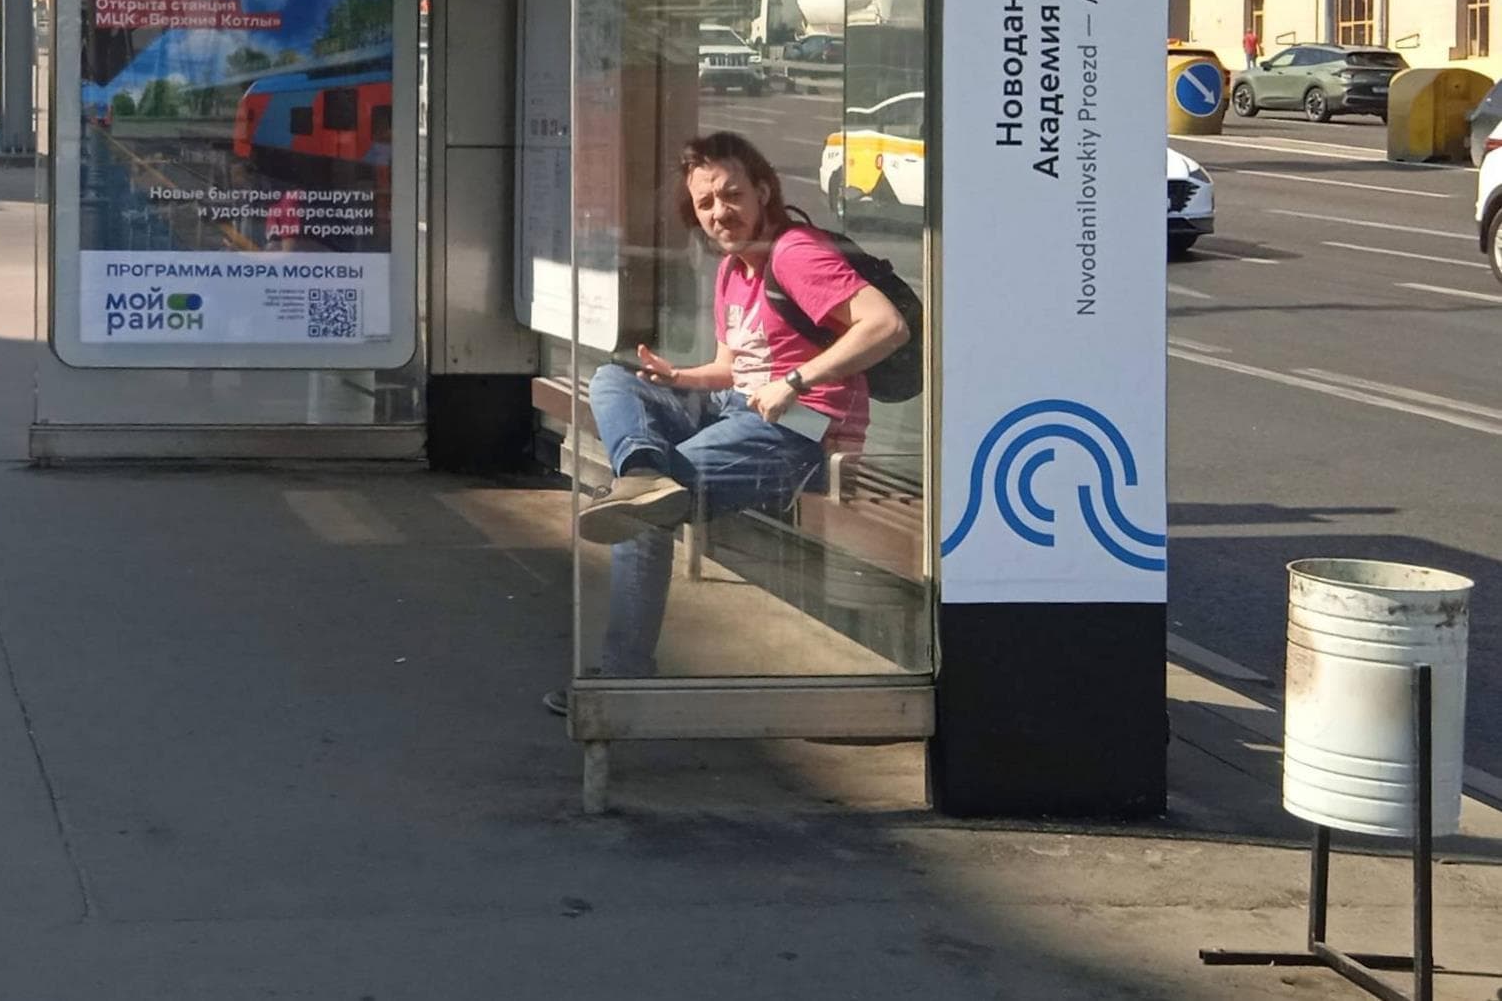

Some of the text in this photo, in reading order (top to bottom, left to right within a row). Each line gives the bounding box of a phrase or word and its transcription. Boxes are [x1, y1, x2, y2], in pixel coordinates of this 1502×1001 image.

[171, 0, 237, 12] станция
[96, 13, 281, 28] МЦК «Верхние Котлы»
[1078, 45, 1097, 121] Proezd
[1033, 5, 1064, 178] Академия
[150, 186, 374, 203] Новые быстрые маршруты
[198, 205, 374, 220] и удобные пересадки
[1077, 129, 1101, 315] Novodanilovskiy
[267, 224, 374, 238] для горожан
[106, 264, 364, 279] ПРОГРАММА МЭРА МОСКВЫ
[105, 286, 165, 311] мой
